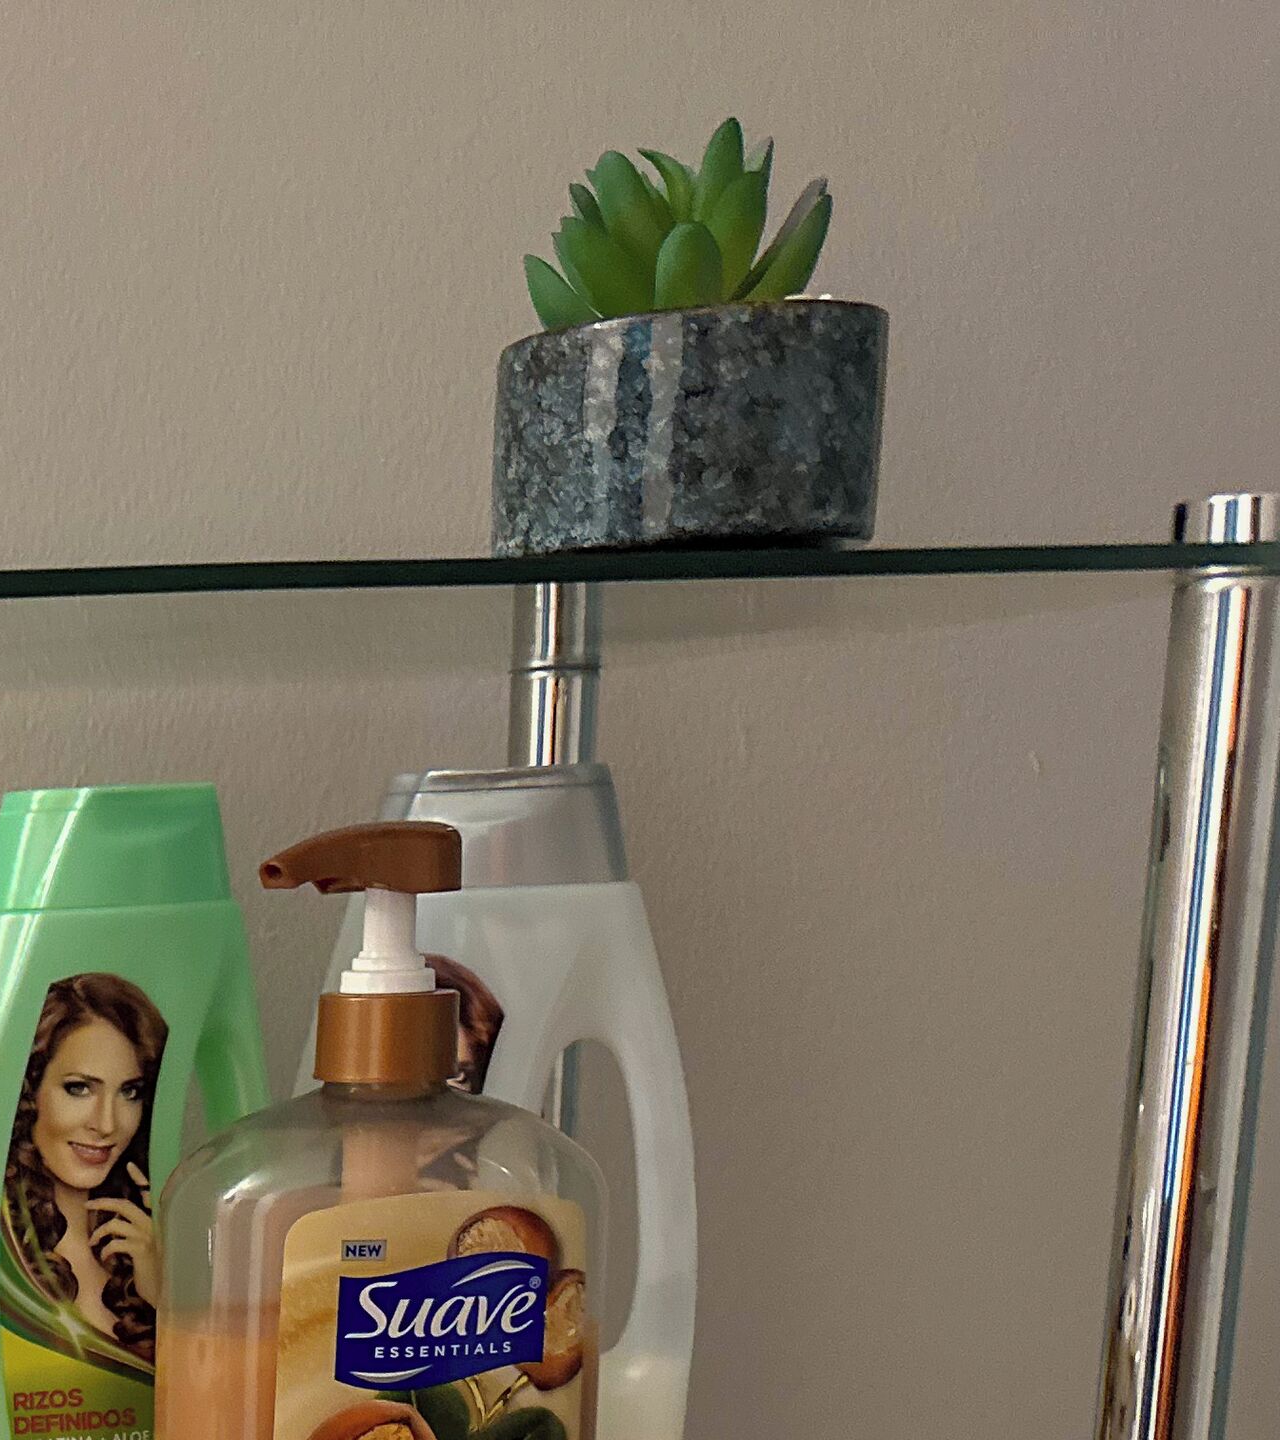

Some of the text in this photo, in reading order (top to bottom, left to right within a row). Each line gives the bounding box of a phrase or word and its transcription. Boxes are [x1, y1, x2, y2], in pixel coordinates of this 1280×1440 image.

[345, 1244, 382, 1258] NEW
[344, 1281, 538, 1339] Suave
[374, 1341, 512, 1359] ESSENTIALS
[13, 1388, 84, 1411] RIZOS
[14, 1408, 137, 1435] DEFINIDOS
